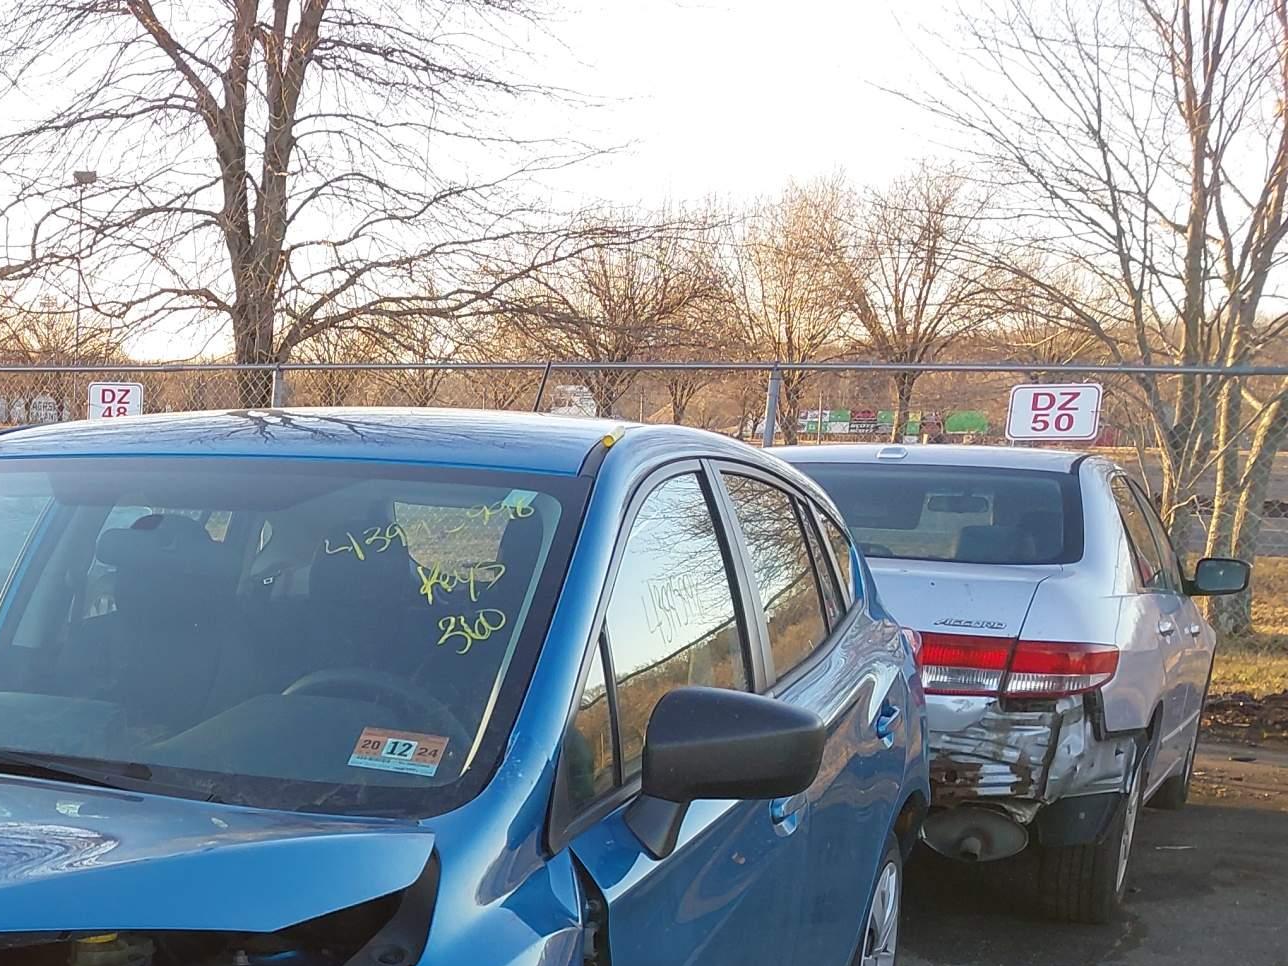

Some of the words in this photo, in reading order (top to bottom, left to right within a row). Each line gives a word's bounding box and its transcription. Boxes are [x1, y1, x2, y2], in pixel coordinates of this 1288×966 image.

[101, 388, 130, 405] DZ
[1031, 391, 1081, 412] DZ
[101, 406, 128, 418] 48
[1031, 413, 1074, 432] 50
[933, 618, 1007, 630] ACCORD
[361, 739, 381, 751] 20
[385, 740, 413, 757] 12
[417, 746, 439, 758] 24
